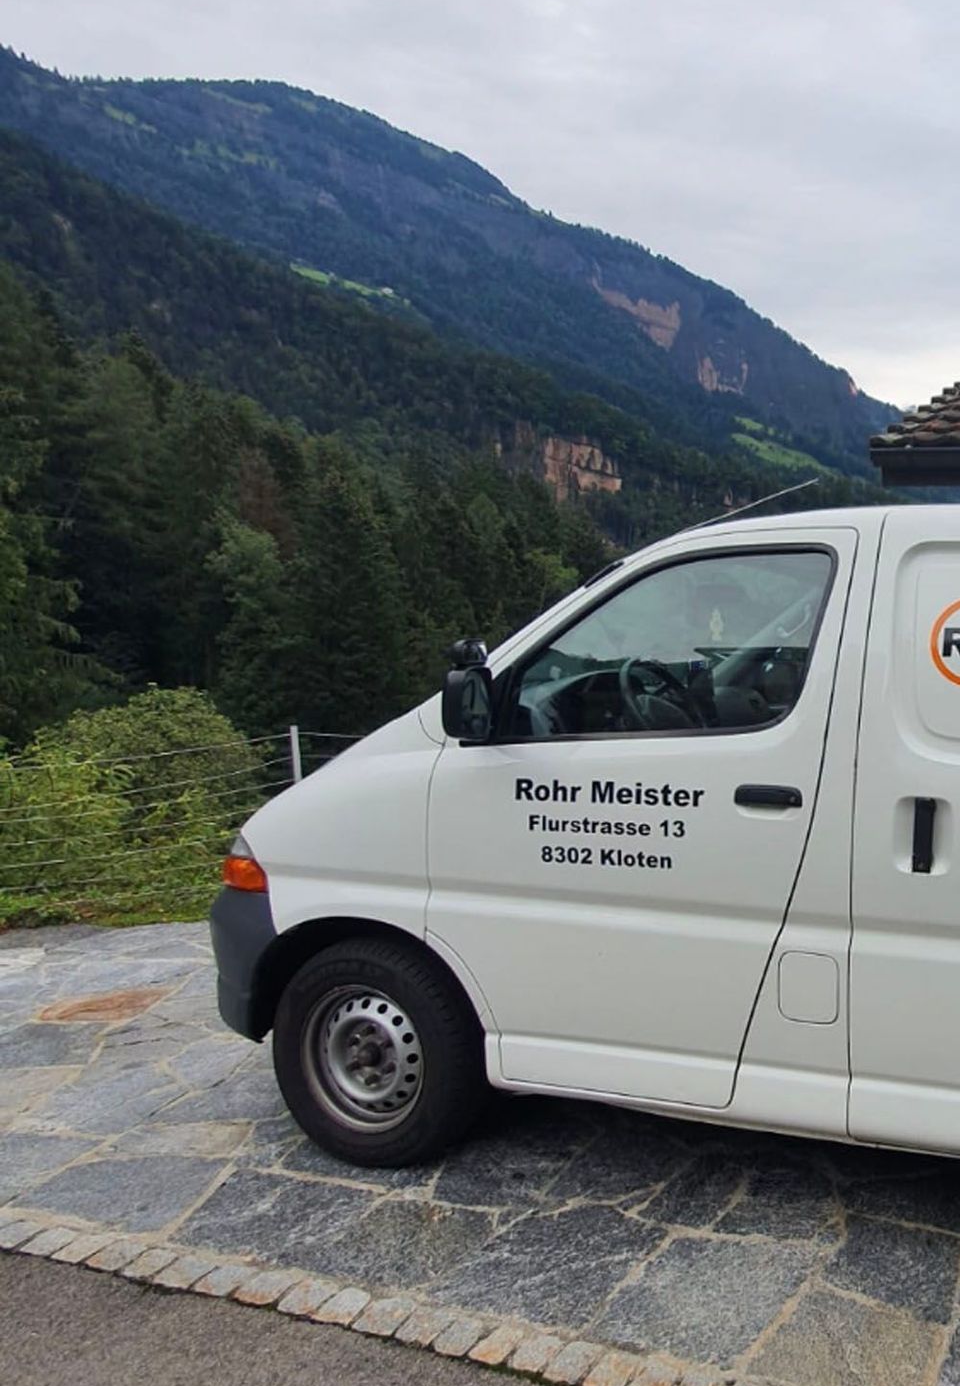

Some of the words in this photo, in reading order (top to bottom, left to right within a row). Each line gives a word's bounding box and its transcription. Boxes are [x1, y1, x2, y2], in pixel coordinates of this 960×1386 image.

[514, 777, 582, 803] Rohr
[590, 780, 706, 808] Meister
[528, 814, 652, 837] Flurstrasse
[660, 819, 686, 839] 13
[540, 845, 593, 865] 8302
[600, 848, 673, 870] Kloten
